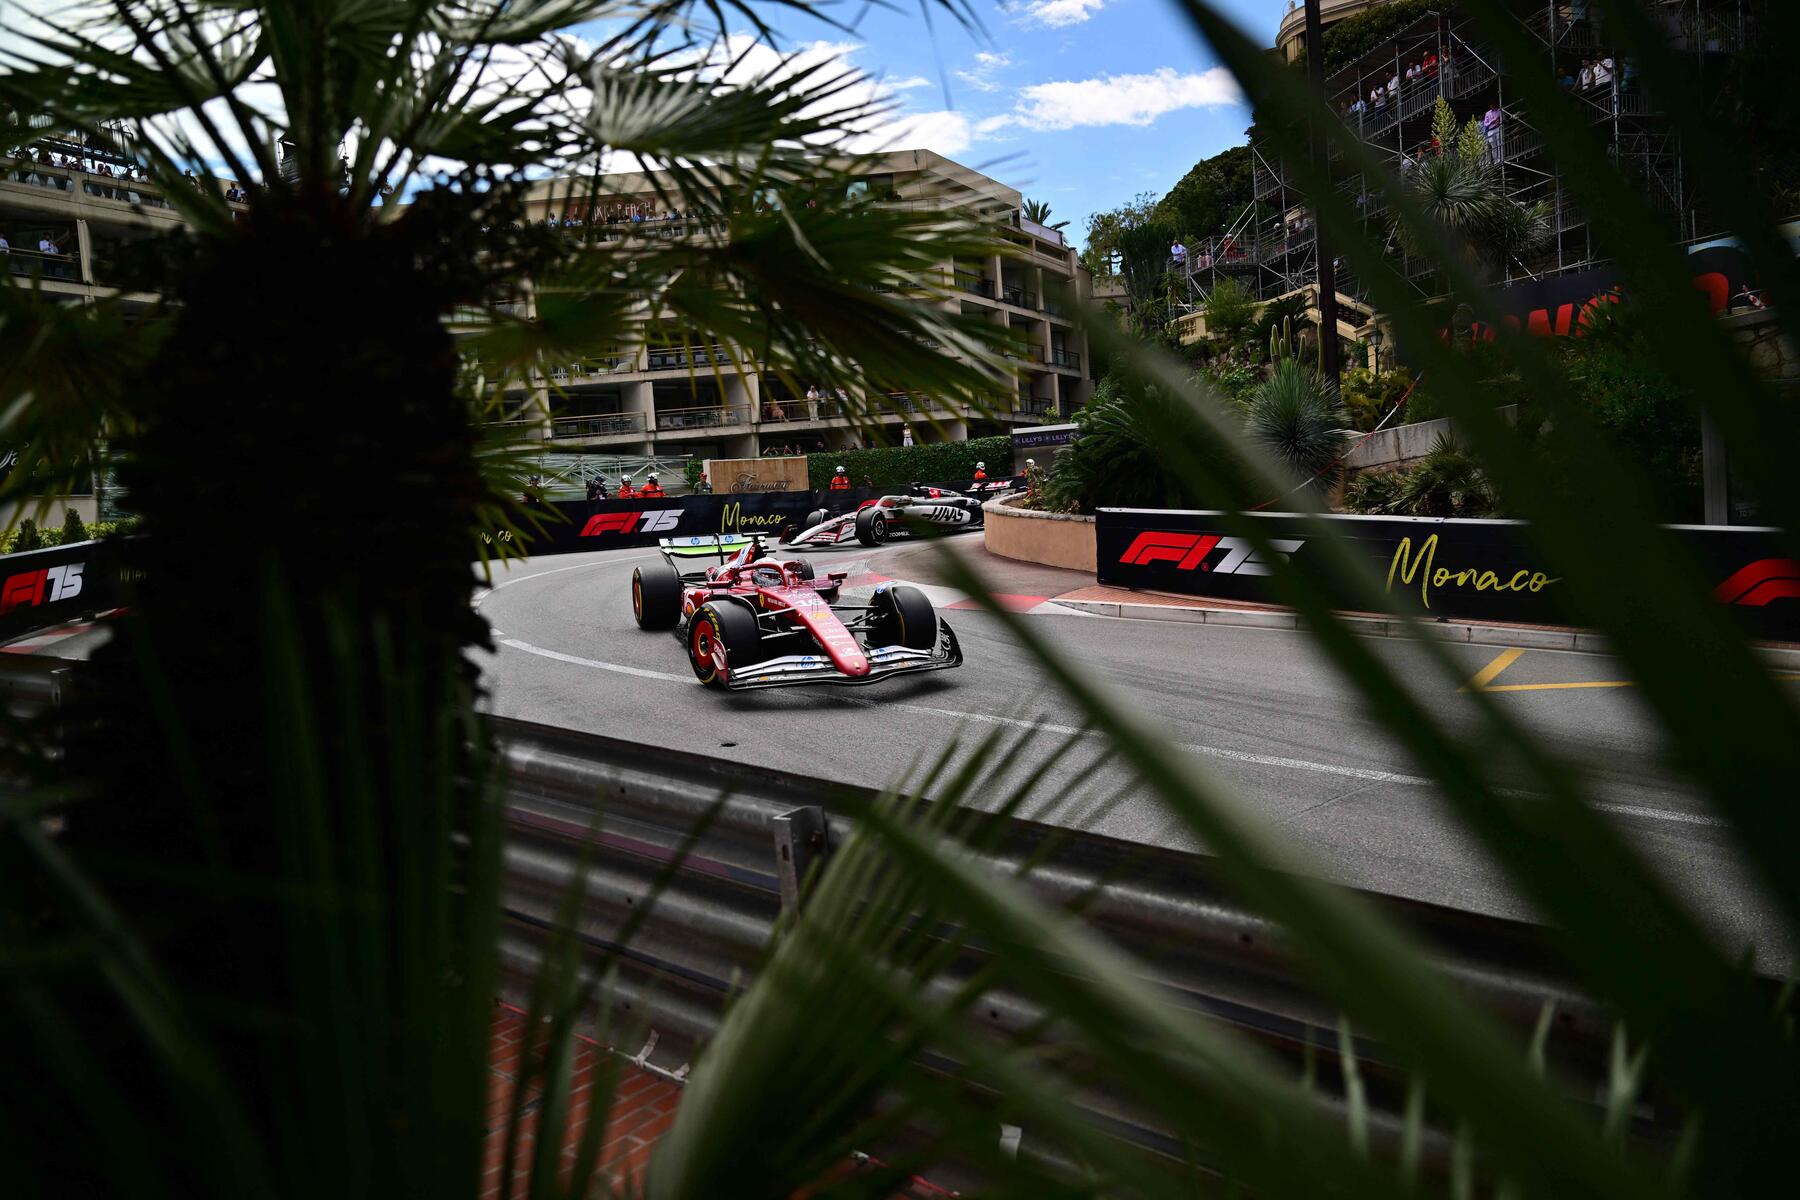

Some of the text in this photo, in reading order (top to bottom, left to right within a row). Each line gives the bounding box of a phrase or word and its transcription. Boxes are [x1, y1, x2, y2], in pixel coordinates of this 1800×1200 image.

[640, 509, 685, 533] 75
[721, 501, 786, 534] Monaco
[922, 507, 963, 522] HAAS
[1386, 533, 1562, 609] Monaco
